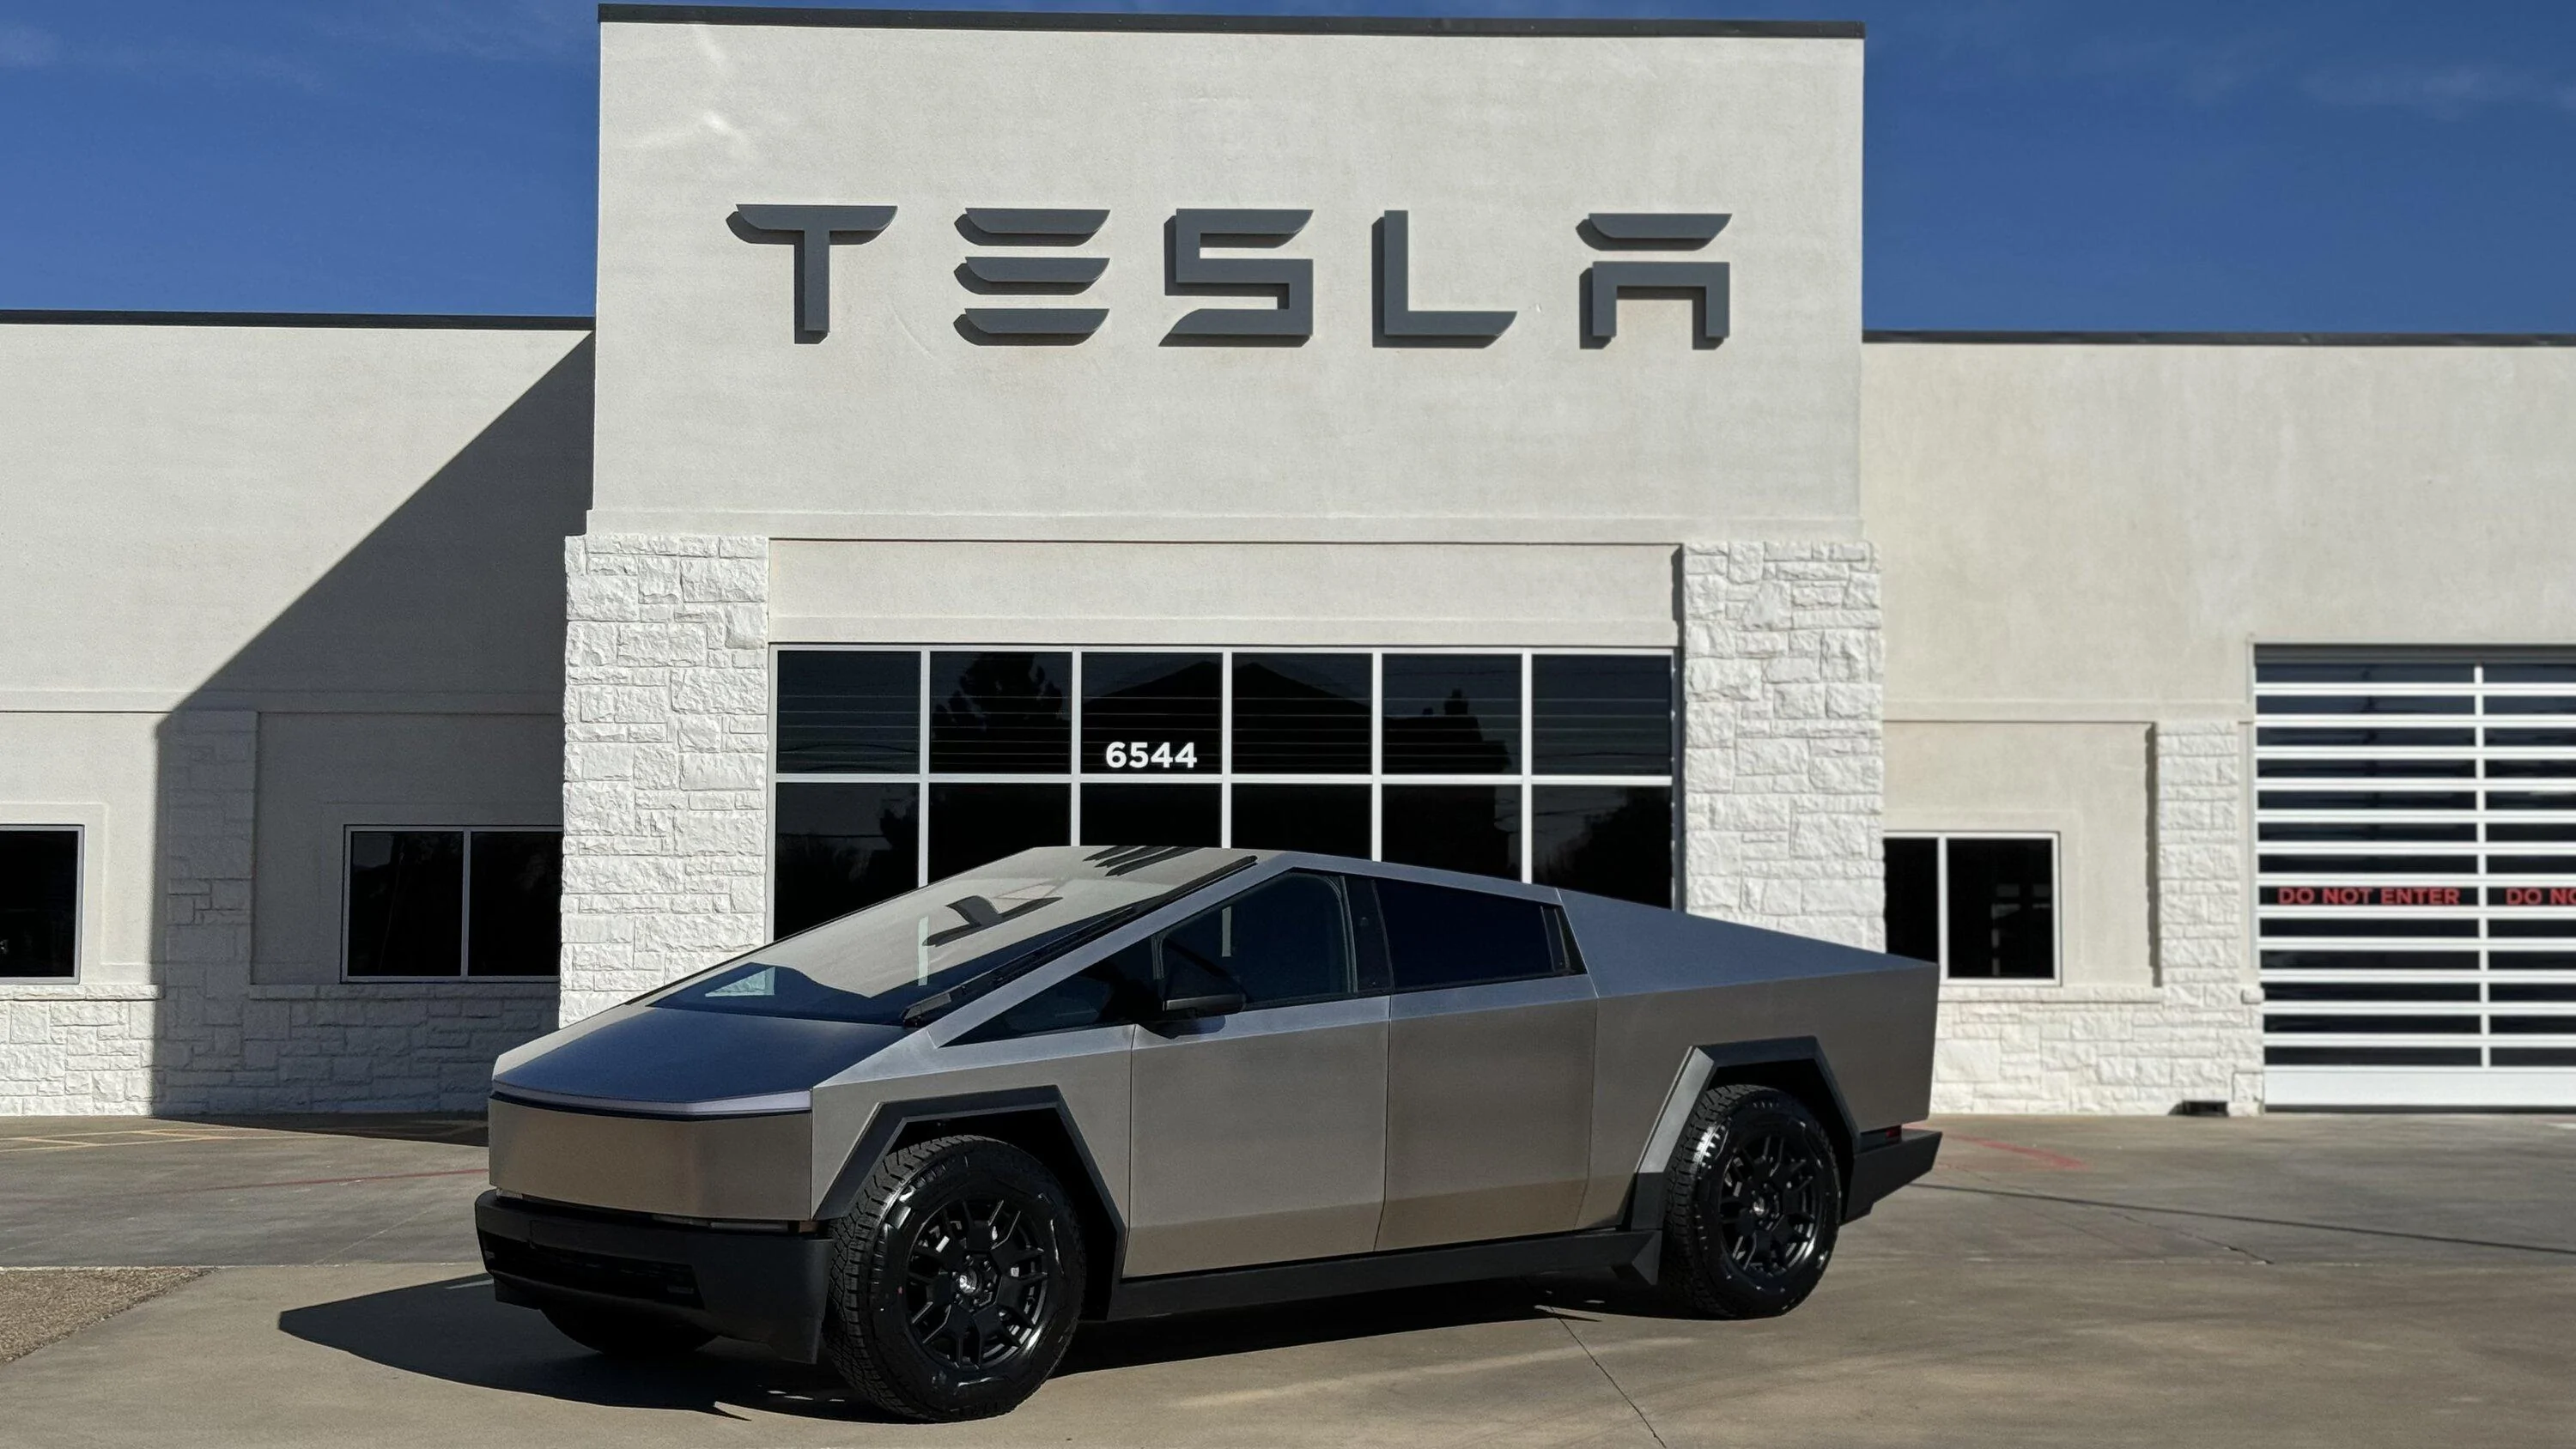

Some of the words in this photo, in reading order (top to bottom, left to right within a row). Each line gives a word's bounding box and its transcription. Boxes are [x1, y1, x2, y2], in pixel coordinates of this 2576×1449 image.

[728, 204, 1732, 347] TESLA
[1105, 741, 1198, 768] 6544
[2277, 887, 2315, 905] DO
[2322, 887, 2372, 905] NOT
[2380, 887, 2461, 905] ENTER
[2506, 888, 2543, 906] DO
